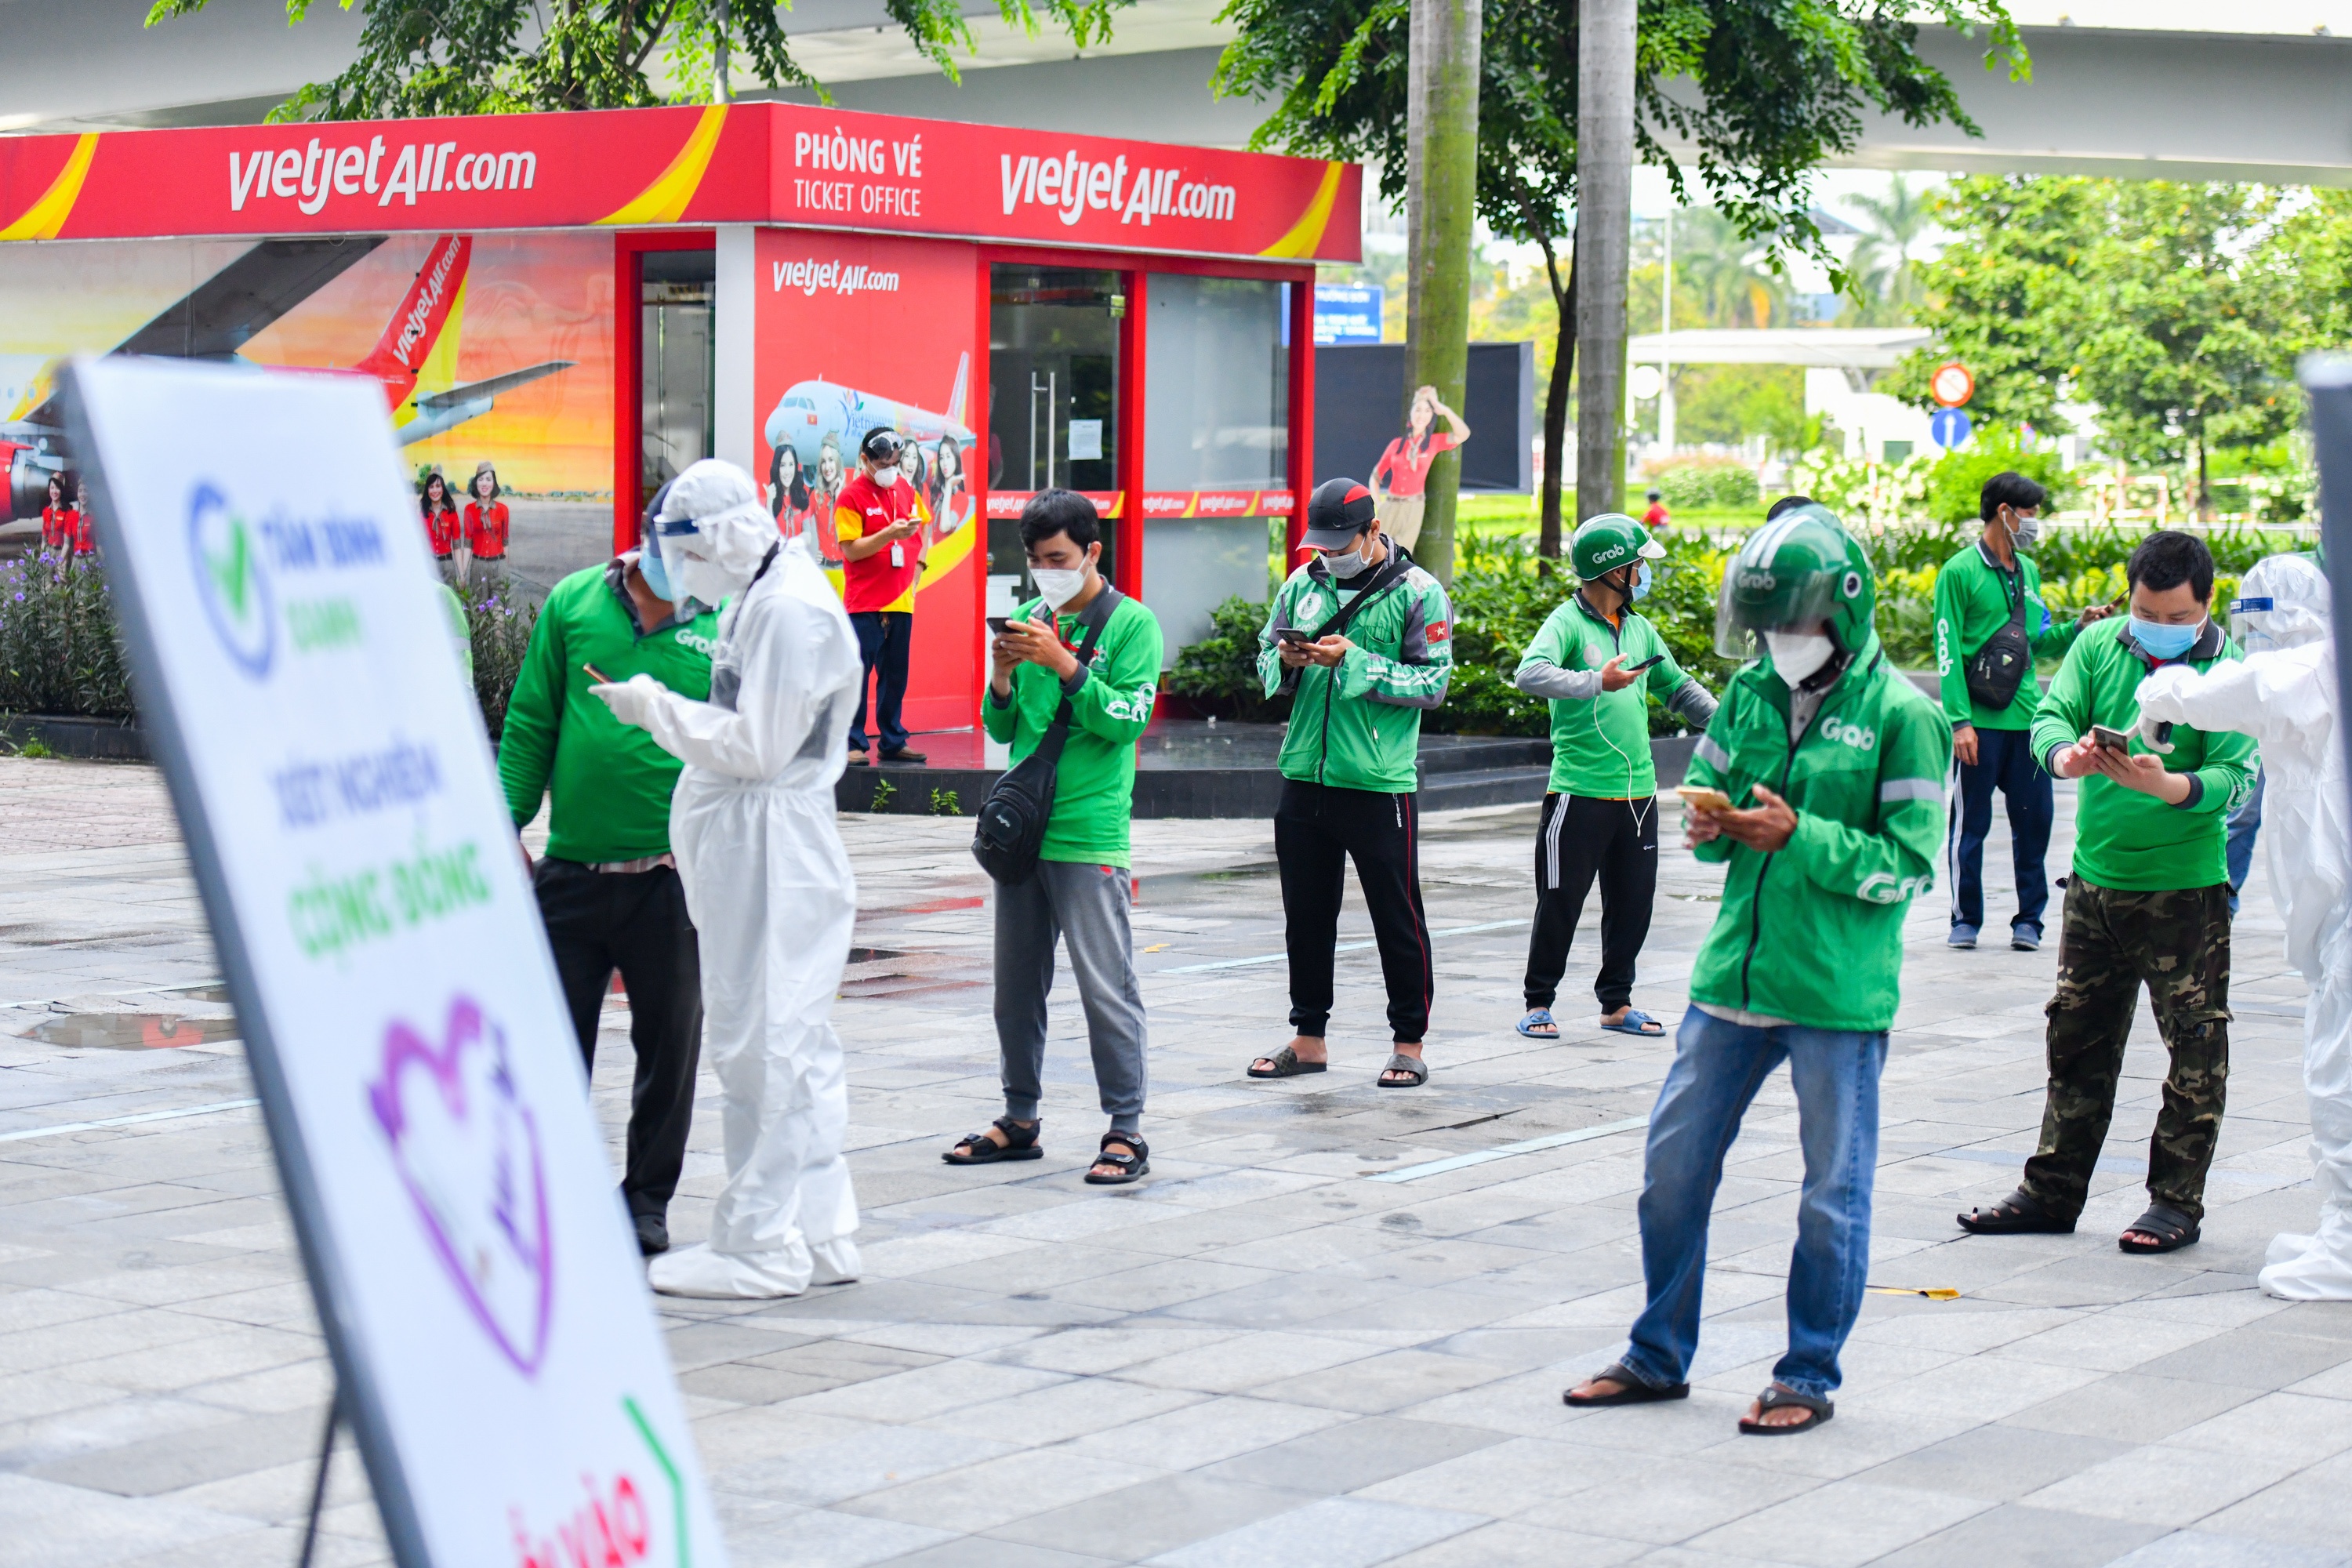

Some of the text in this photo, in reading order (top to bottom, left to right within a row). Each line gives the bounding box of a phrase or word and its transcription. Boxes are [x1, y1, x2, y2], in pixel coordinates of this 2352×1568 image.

[794, 125, 922, 179] PHÒNG VÉ
[794, 179, 921, 217] TICKET OFFICE
[1592, 543, 1625, 564] Grab
[1737, 570, 1777, 591] Grab
[1428, 645, 1451, 659] Gra
[1936, 617, 1954, 677] Grab
[1820, 716, 1875, 751] Grab
[1856, 872, 1934, 905] Gra
